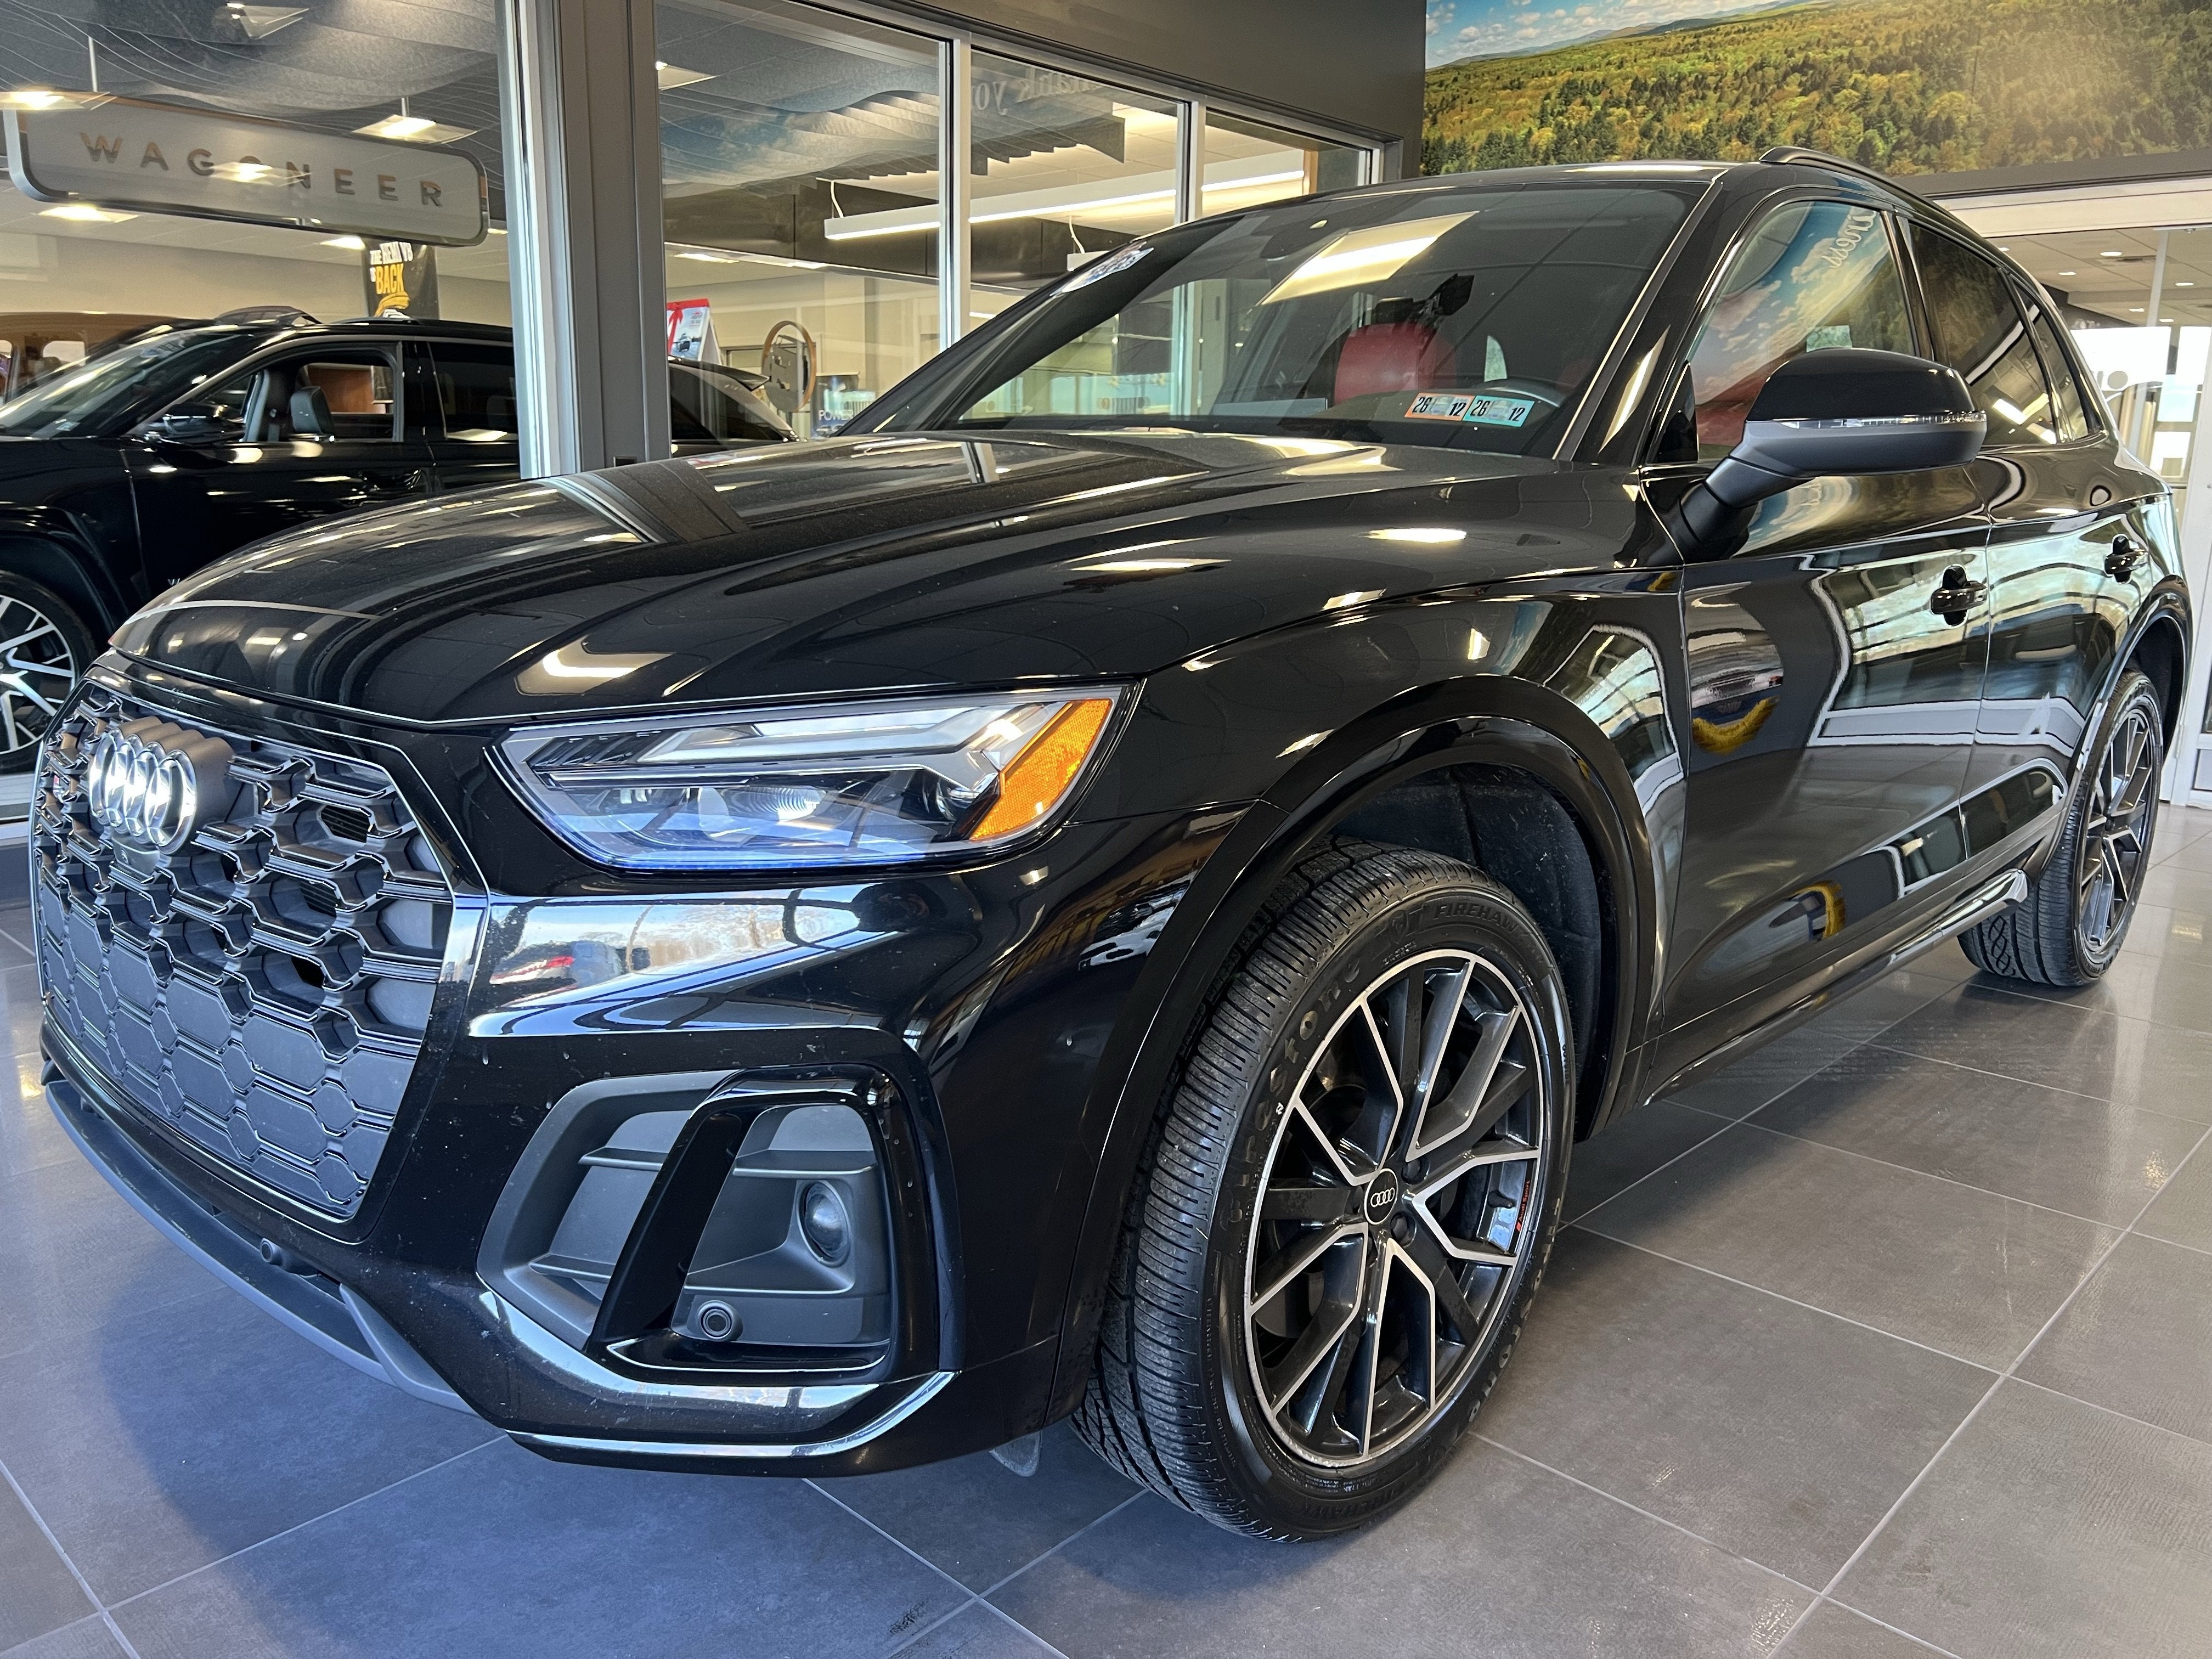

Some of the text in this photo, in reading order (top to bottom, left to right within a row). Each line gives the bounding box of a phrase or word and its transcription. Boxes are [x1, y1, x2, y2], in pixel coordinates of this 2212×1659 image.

[81, 132, 443, 207] WAGNEER
[375, 263, 405, 295] BACK
[1412, 397, 1467, 417] 26 12
[1470, 399, 1526, 422] 26 12
[1522, 1180, 1531, 1203] Sport
